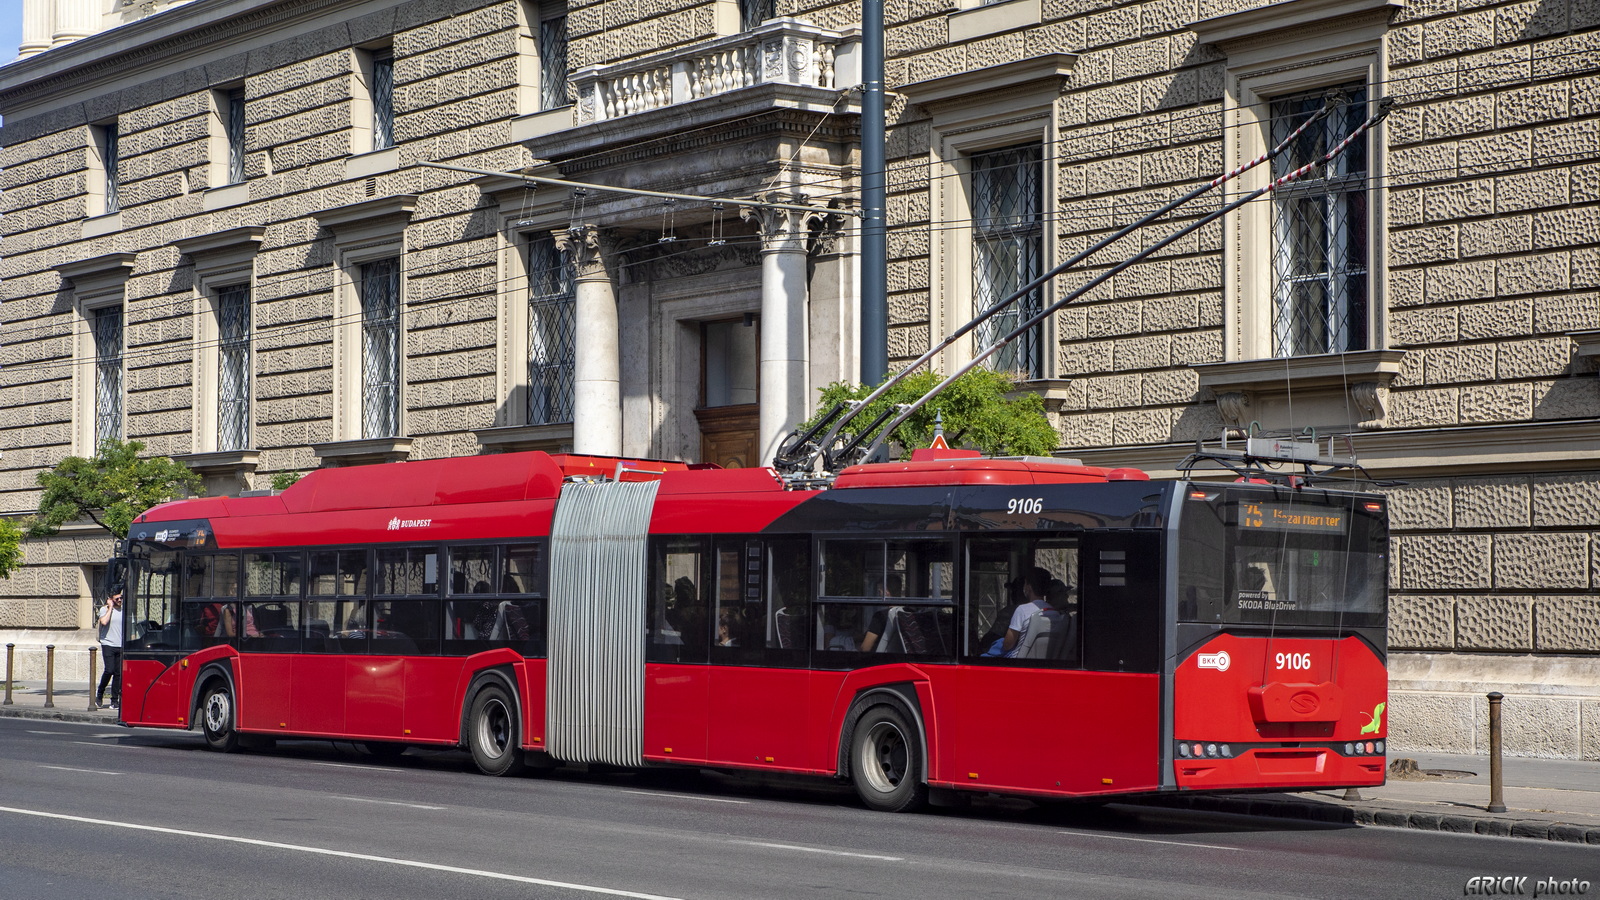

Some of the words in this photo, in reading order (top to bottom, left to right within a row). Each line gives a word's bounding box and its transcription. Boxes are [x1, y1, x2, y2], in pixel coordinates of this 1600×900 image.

[1007, 498, 1043, 515] 9106
[400, 518, 432, 528] BUDAPEST
[1238, 592, 1261, 600] powered
[1261, 592, 1269, 600] by
[1263, 601, 1296, 611] BlueDrive
[1275, 652, 1311, 670] 9106
